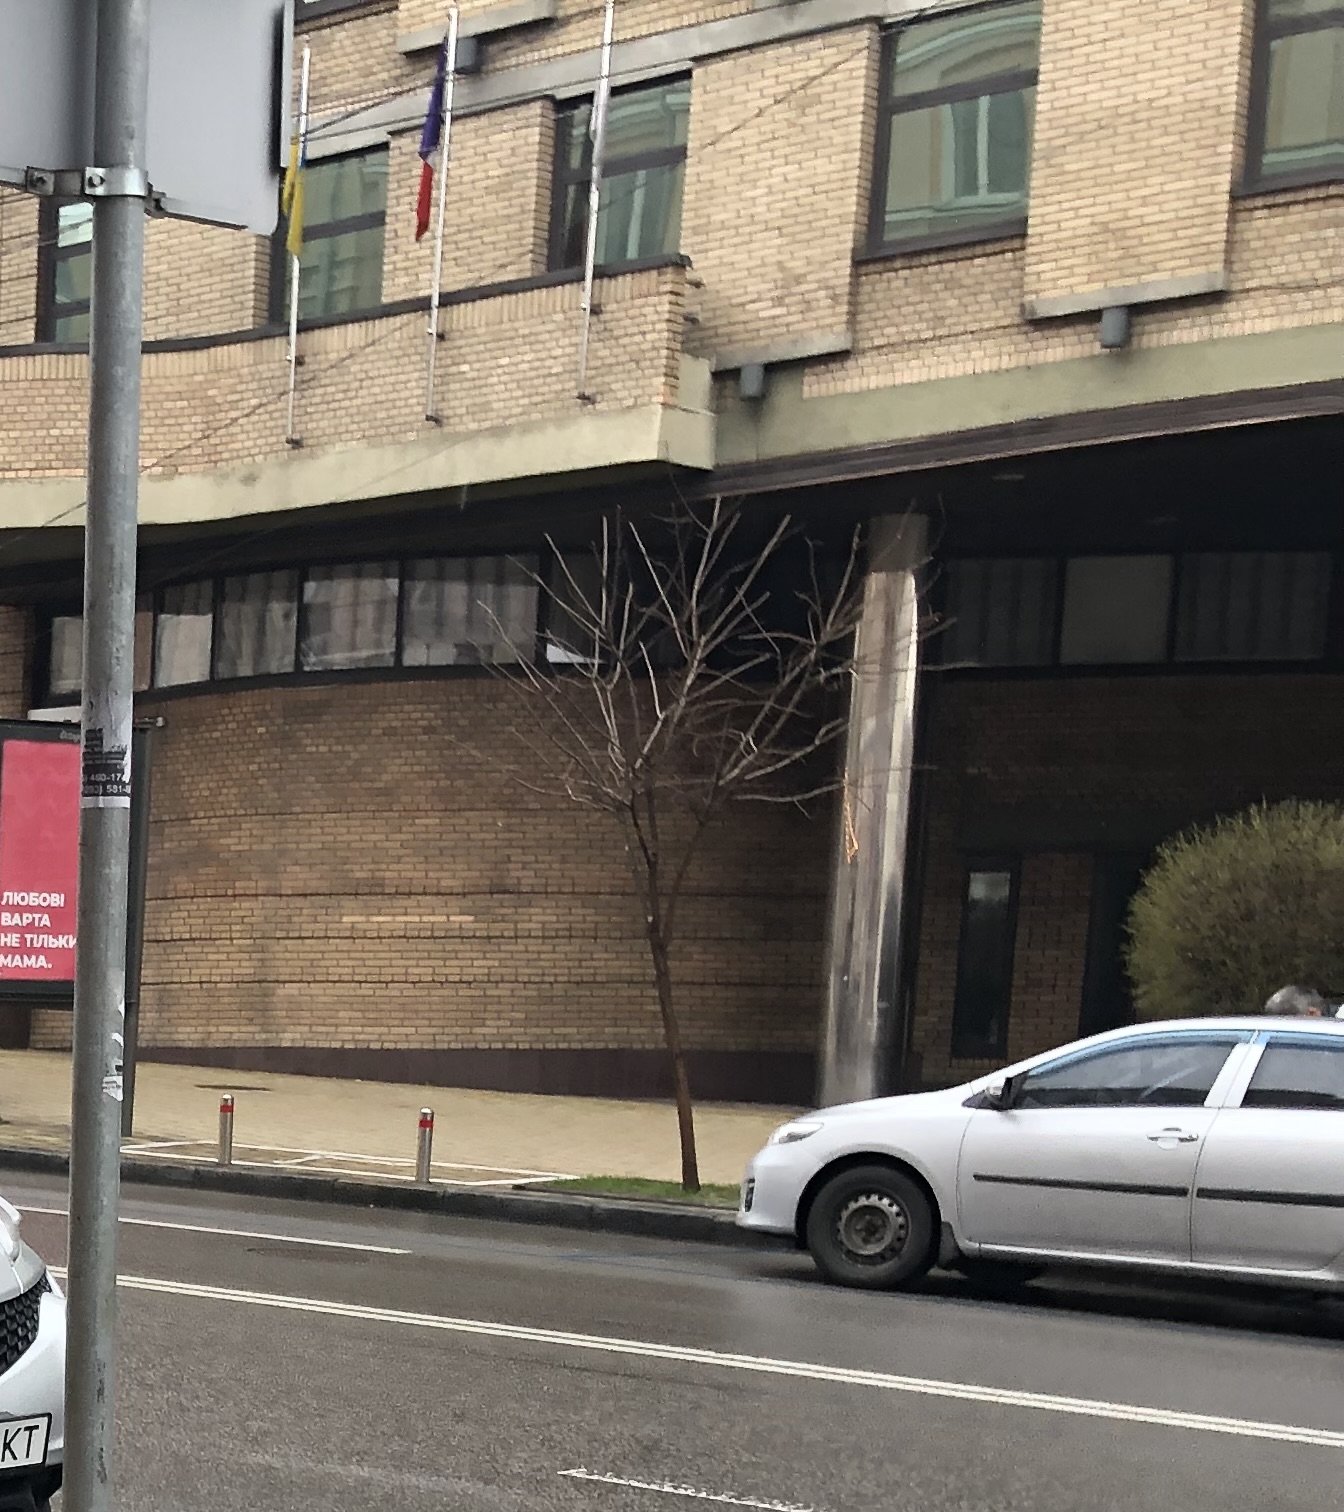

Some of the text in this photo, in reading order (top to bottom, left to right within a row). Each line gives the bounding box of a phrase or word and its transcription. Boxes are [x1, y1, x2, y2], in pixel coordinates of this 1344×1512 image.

[1, 891, 65, 908] ЛЮБОВІ
[0, 911, 52, 928] ВАРТА
[0, 932, 77, 949] НЕ ТІЛЬКИ
[1, 1424, 40, 1463] KT
